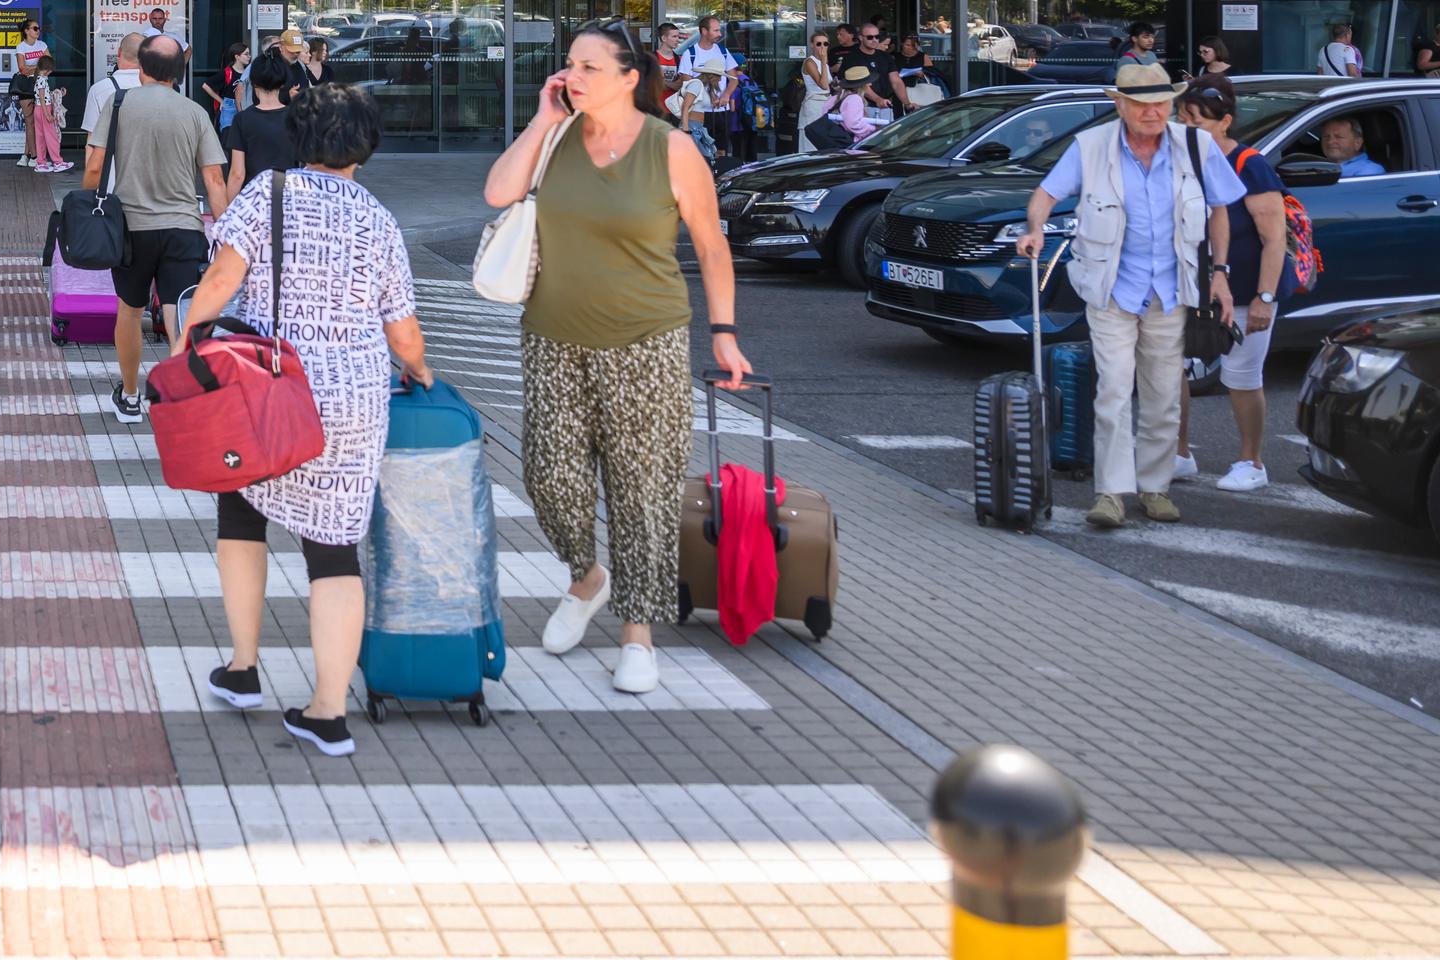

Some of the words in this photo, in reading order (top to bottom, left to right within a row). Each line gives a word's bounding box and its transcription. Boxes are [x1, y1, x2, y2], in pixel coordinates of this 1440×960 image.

[100, 10, 170, 24] transpt
[342, 200, 352, 233] SPORT
[350, 212, 370, 305] VITAMINS
[889, 264, 901, 280] BT
[282, 277, 327, 292] OCTOR
[259, 280, 269, 317] FOOD
[282, 292, 327, 303] NOVATION
[284, 303, 327, 321] EART
[327, 346, 340, 385] WATER
[339, 346, 350, 373] GOOD
[352, 356, 365, 380] DIET
[312, 361, 324, 386] DIET
[333, 401, 343, 418] LIFE
[285, 482, 331, 501] RESOURCE
[321, 504, 331, 529] FOOD
[333, 497, 344, 530] SPORT
[288, 523, 333, 542] HUMAN
